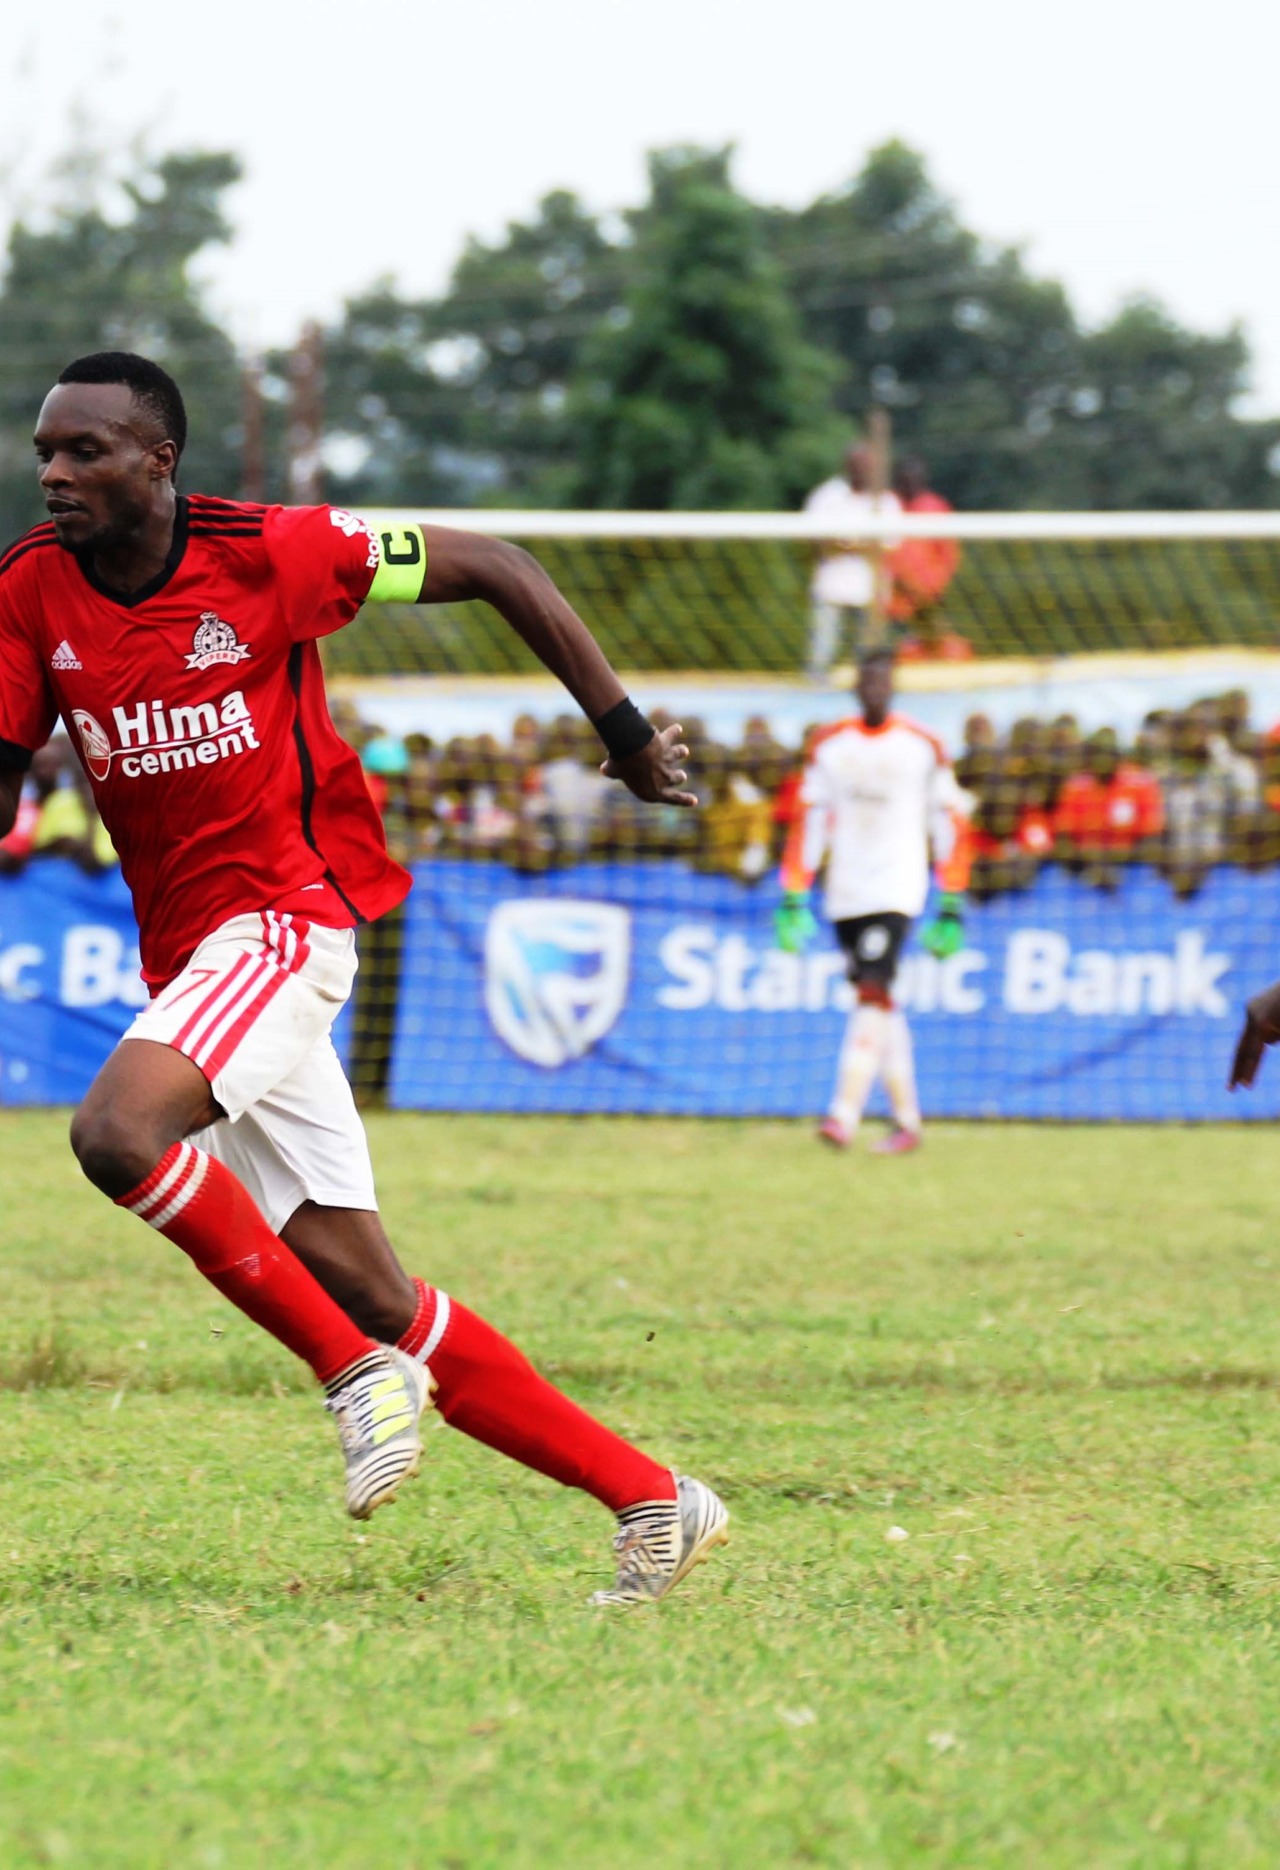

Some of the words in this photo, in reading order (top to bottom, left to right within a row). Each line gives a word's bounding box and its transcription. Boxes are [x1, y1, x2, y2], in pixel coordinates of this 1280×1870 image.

[381, 531, 420, 565] C
[51, 659, 83, 671] adidas
[199, 652, 237, 667] VIPERS
[111, 690, 251, 748] Hima
[121, 718, 260, 778] cement
[1004, 928, 1232, 1018] Bank
